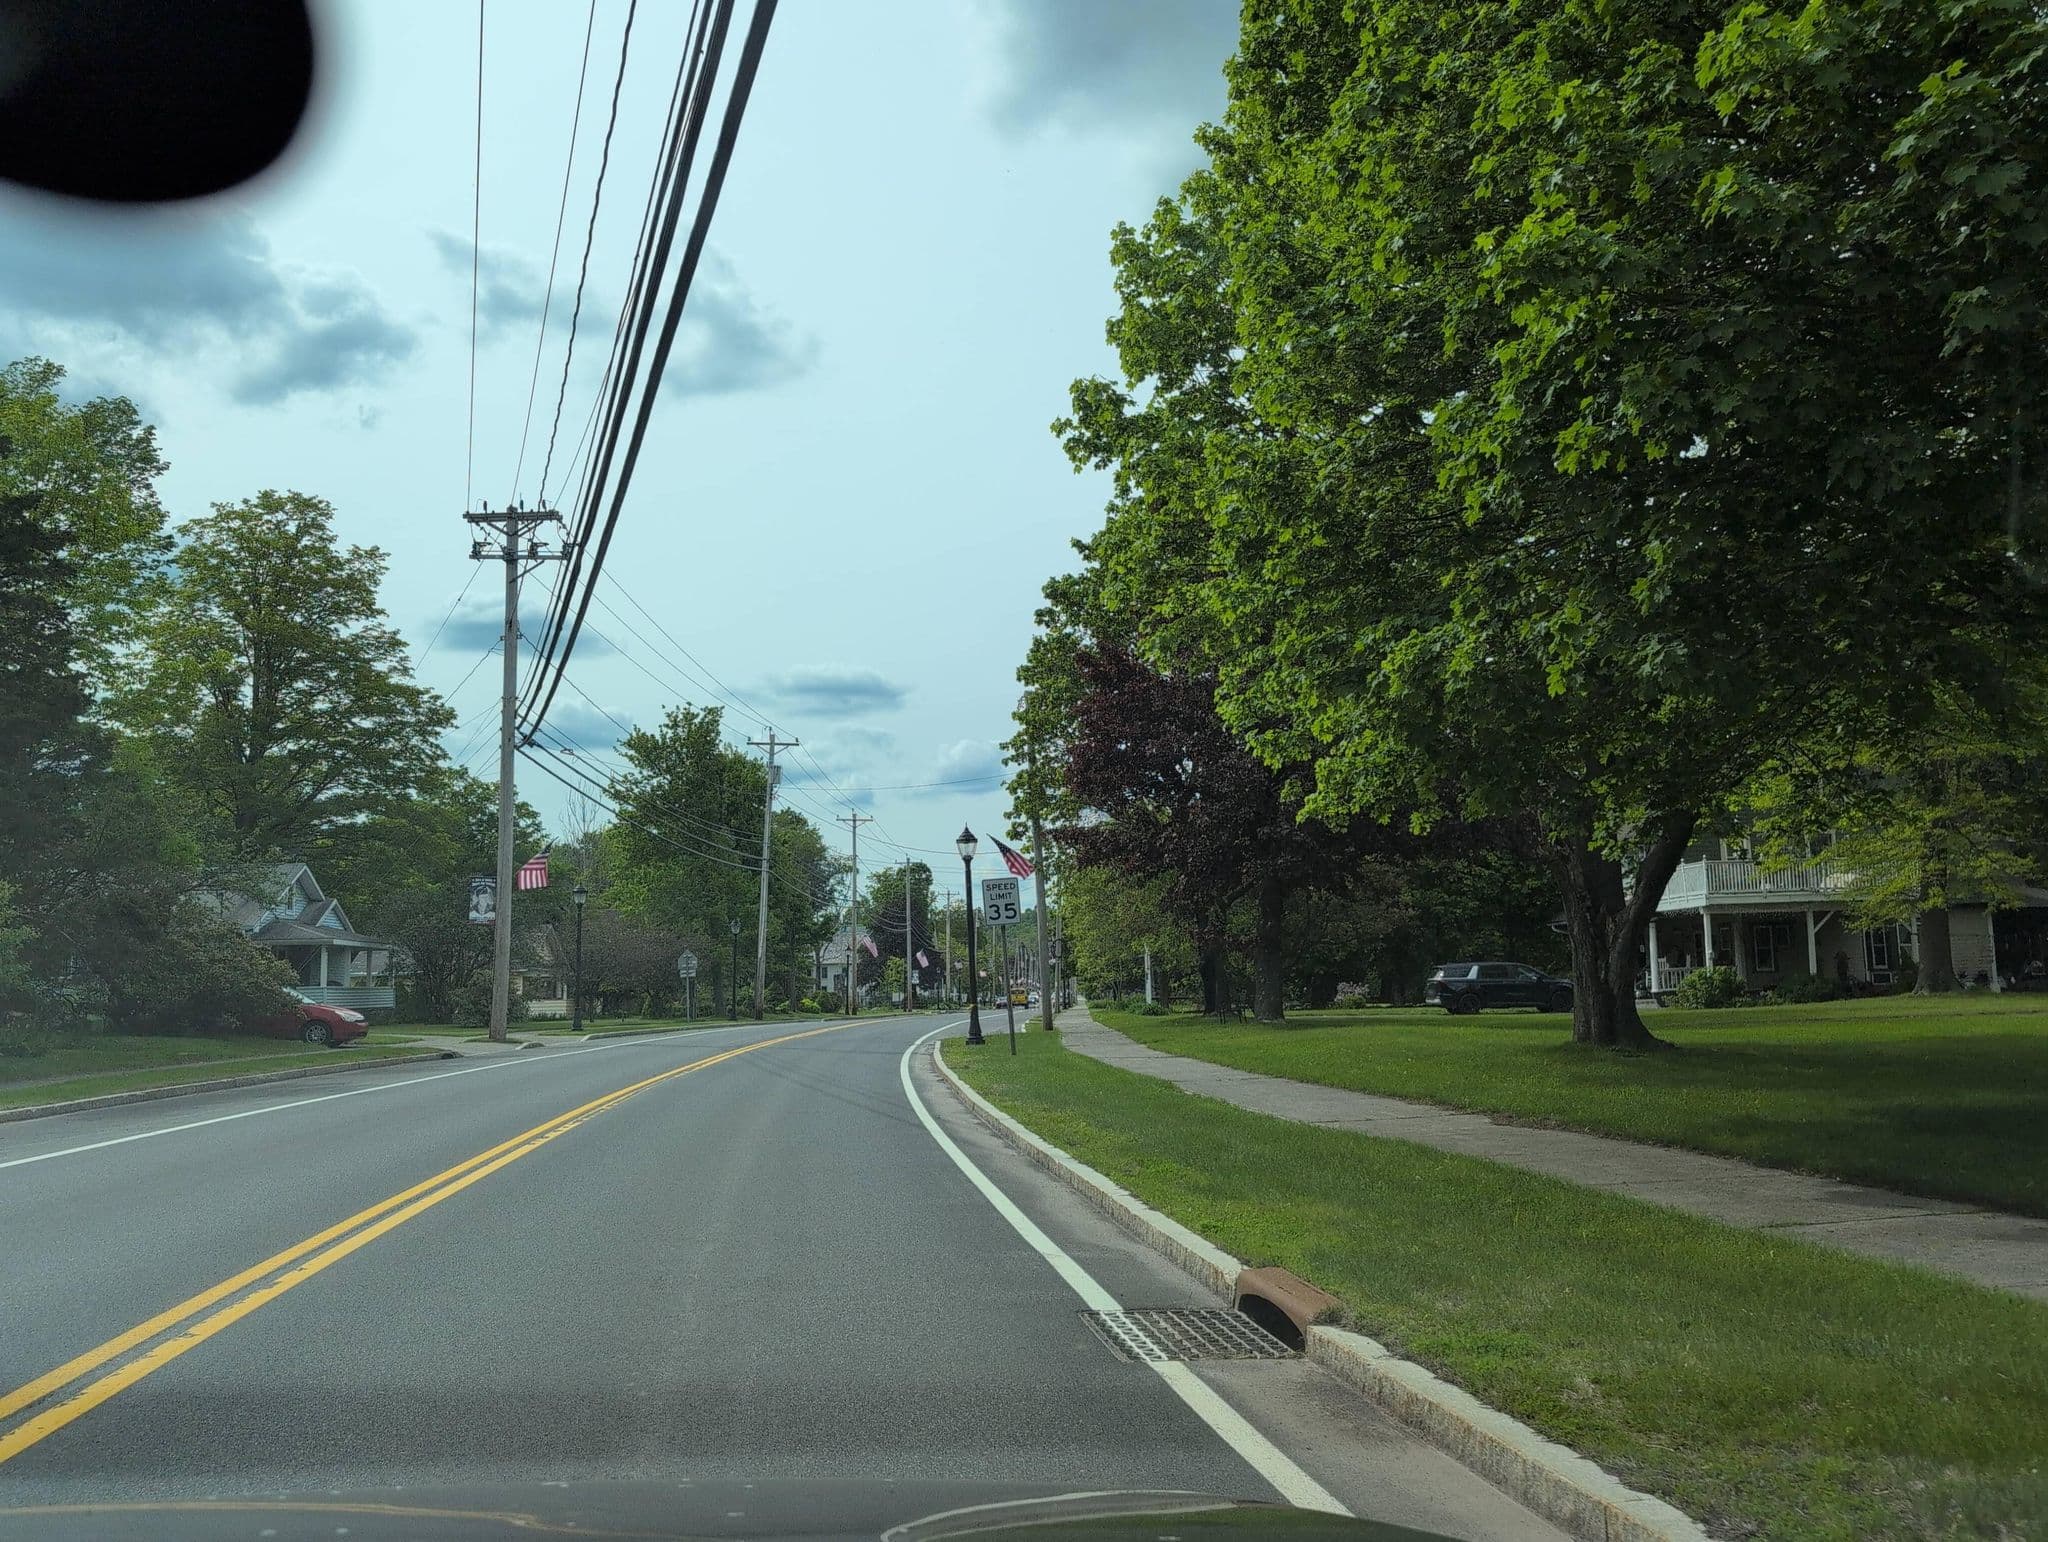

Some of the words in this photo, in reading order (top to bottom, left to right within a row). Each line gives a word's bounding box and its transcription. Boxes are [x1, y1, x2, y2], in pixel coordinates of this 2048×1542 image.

[986, 882, 1016, 891] SPEED
[990, 892, 1012, 901] LIMIT
[989, 903, 1017, 920] 35
